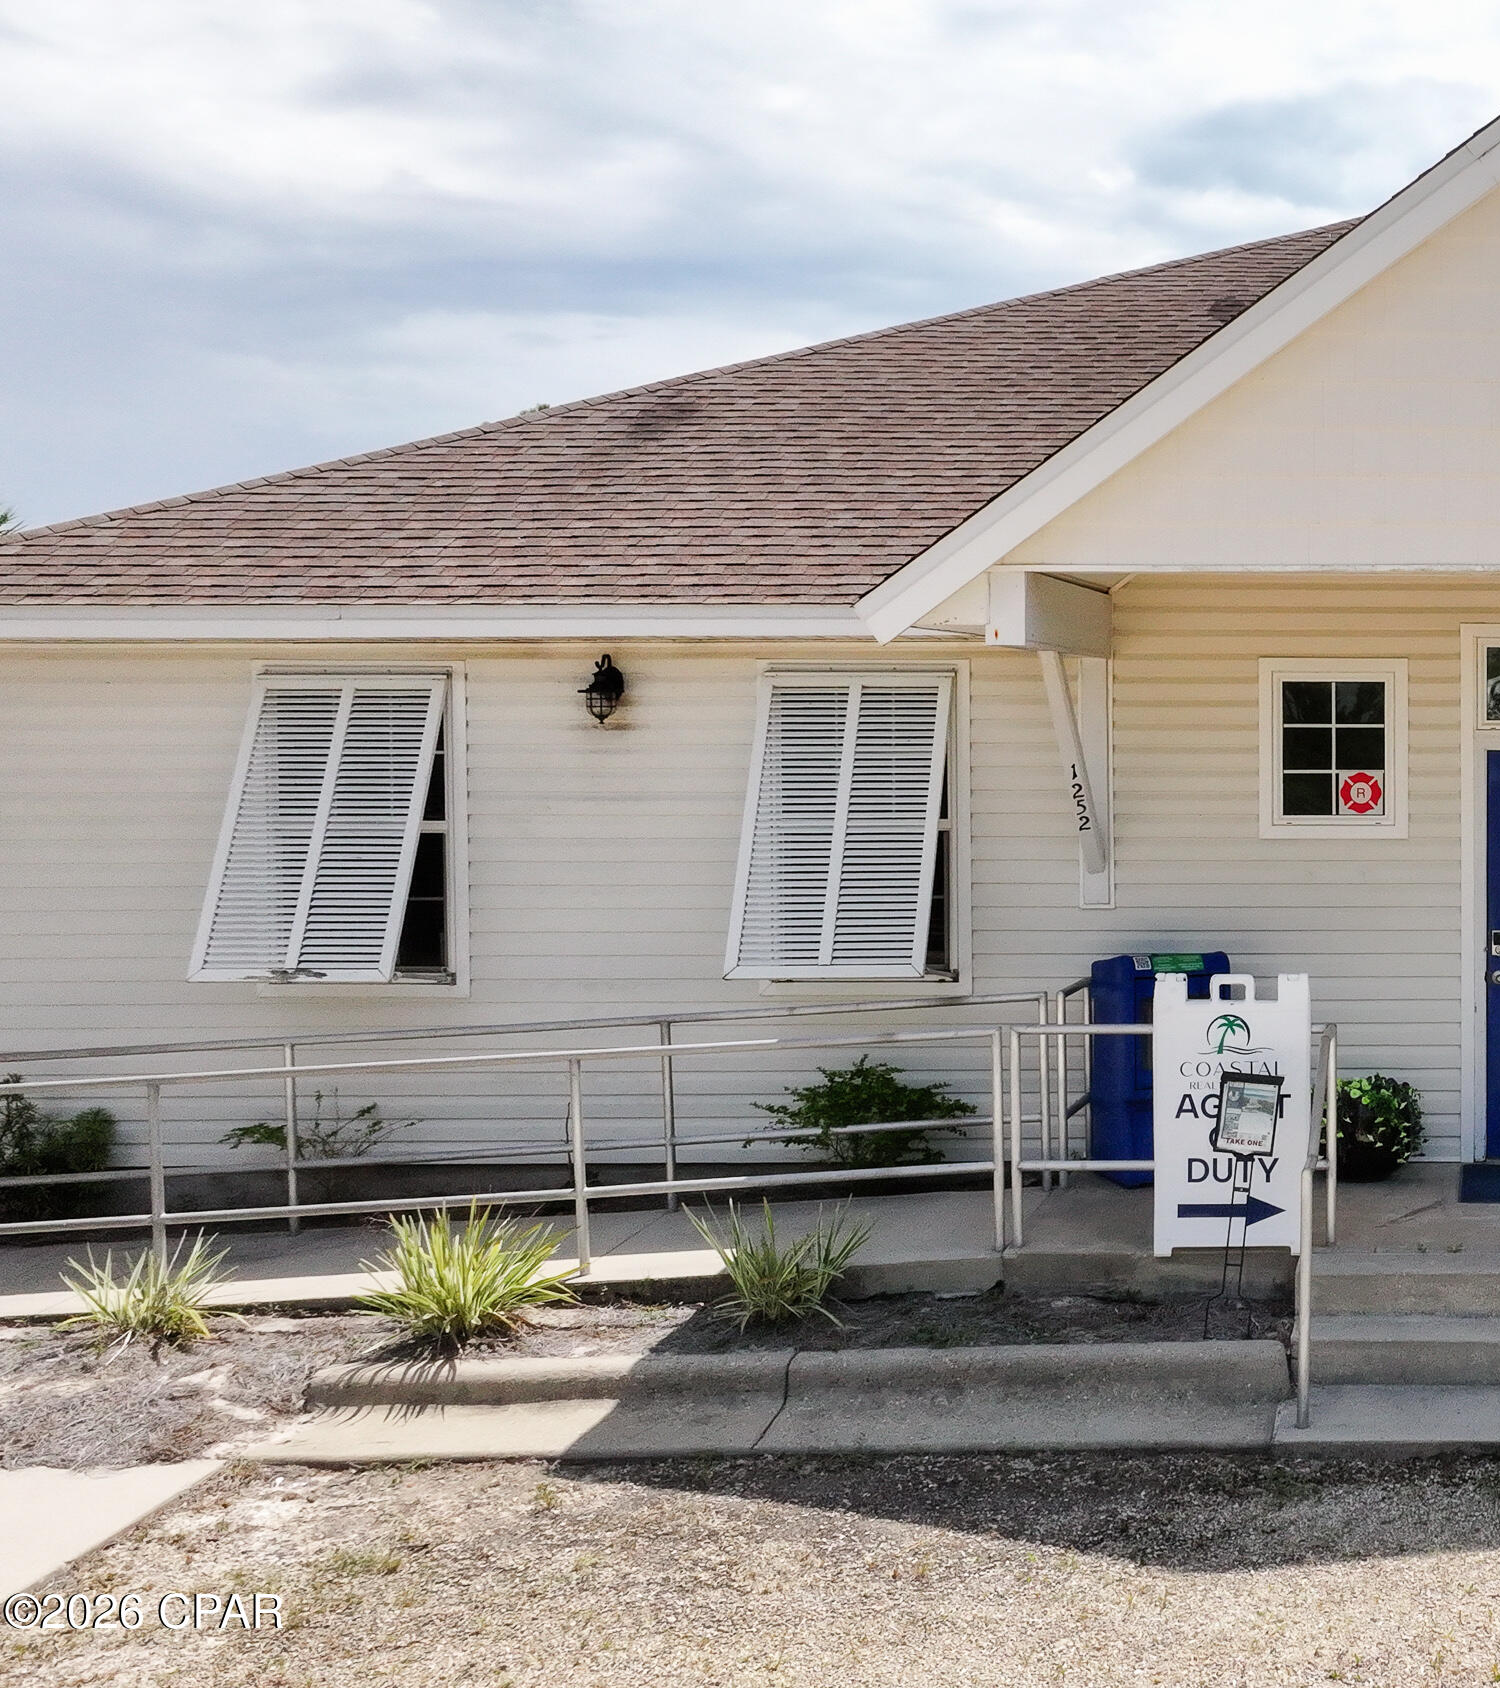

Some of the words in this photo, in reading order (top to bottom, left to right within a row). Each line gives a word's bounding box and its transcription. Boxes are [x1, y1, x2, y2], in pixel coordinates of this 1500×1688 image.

[1070, 763, 1091, 832] 1252
[1356, 787, 1366, 799] R
[1180, 1061, 1281, 1077] COASTAL
[1175, 1093, 1292, 1119] AGT
[1225, 1138, 1246, 1146] TAKE
[1247, 1139, 1264, 1147] ONE
[1187, 1157, 1280, 1183] DUTY
